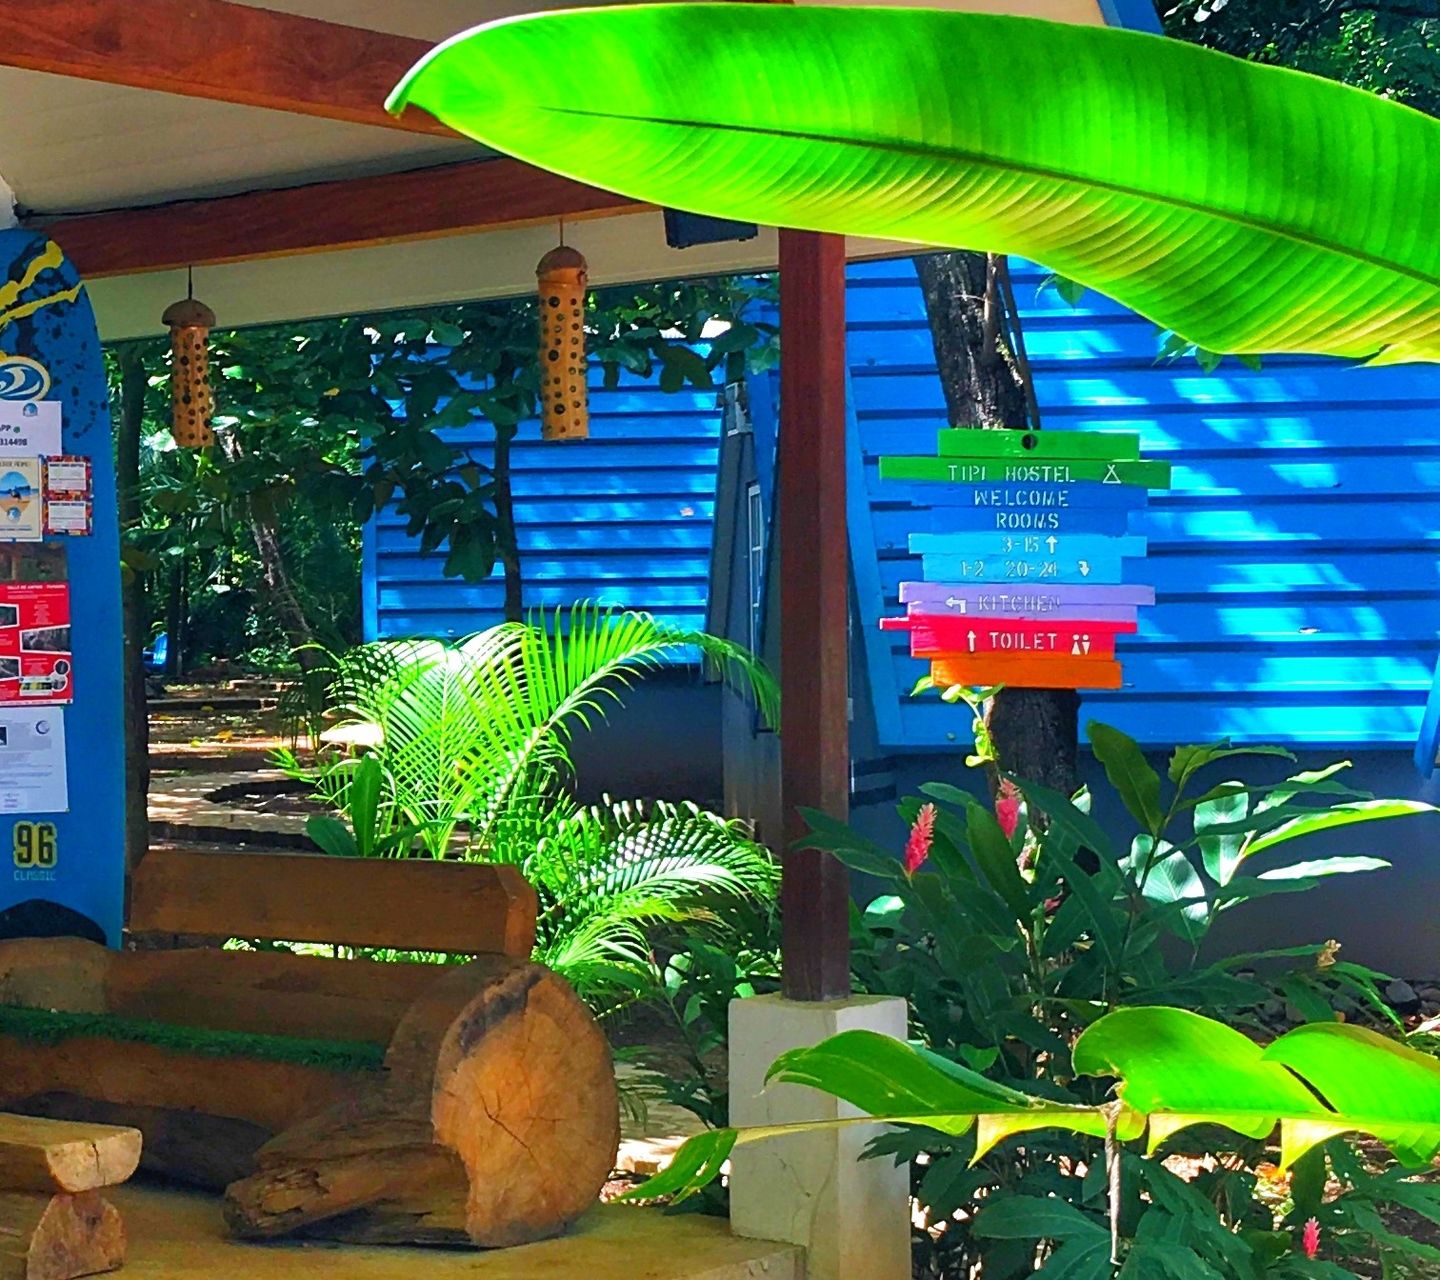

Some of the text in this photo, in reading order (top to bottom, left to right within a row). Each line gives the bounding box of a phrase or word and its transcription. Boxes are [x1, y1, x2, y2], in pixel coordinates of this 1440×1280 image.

[948, 465, 1076, 482] TIPI HOSTEL
[974, 490, 1069, 507] WELCOME
[996, 512, 1059, 529] ROOMS
[1002, 536, 1039, 552] 3-15
[962, 561, 1058, 577] 1-2 20-24
[979, 595, 1060, 612] KITCHEN
[989, 632, 1057, 649] TOILET
[13, 821, 57, 868] 96
